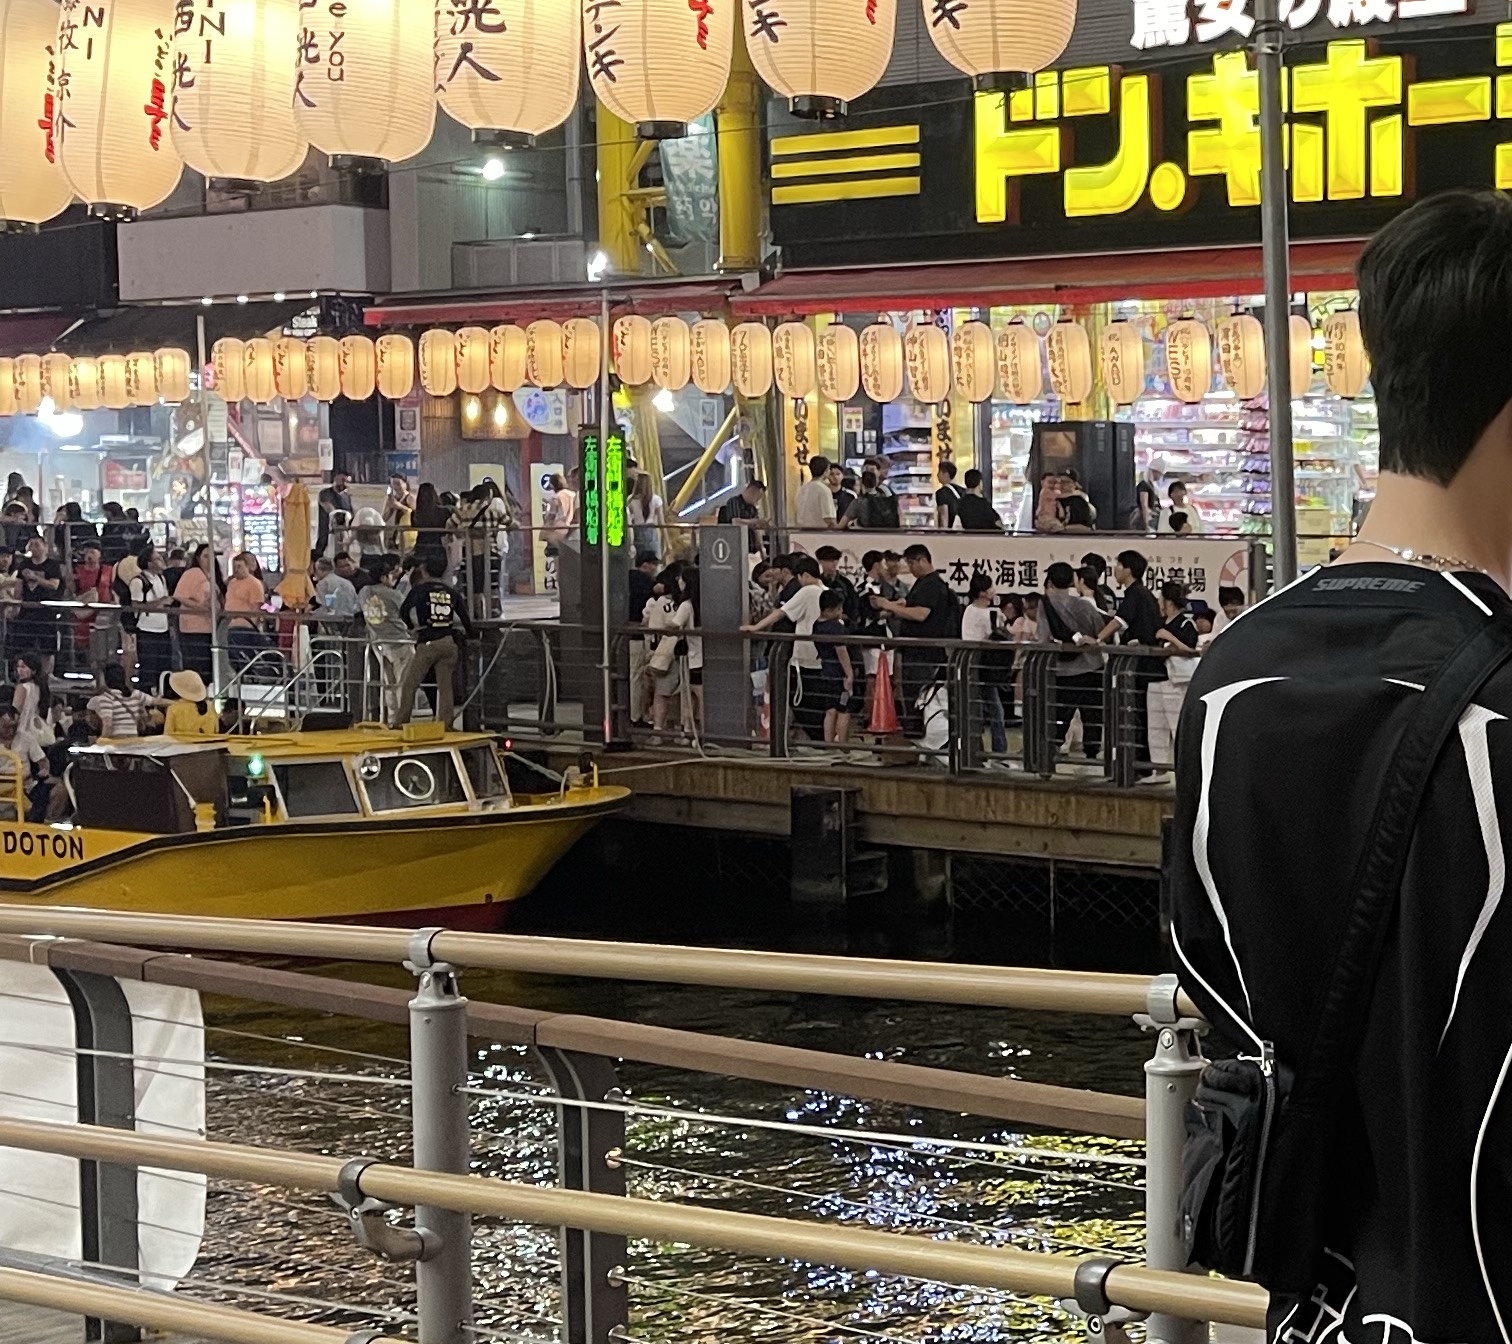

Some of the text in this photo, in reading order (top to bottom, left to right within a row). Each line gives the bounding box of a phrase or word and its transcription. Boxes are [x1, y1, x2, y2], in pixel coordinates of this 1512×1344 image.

[327, 30, 345, 82] you
[1312, 577, 1425, 594] SUPREME
[2, 830, 85, 861] DOTON
